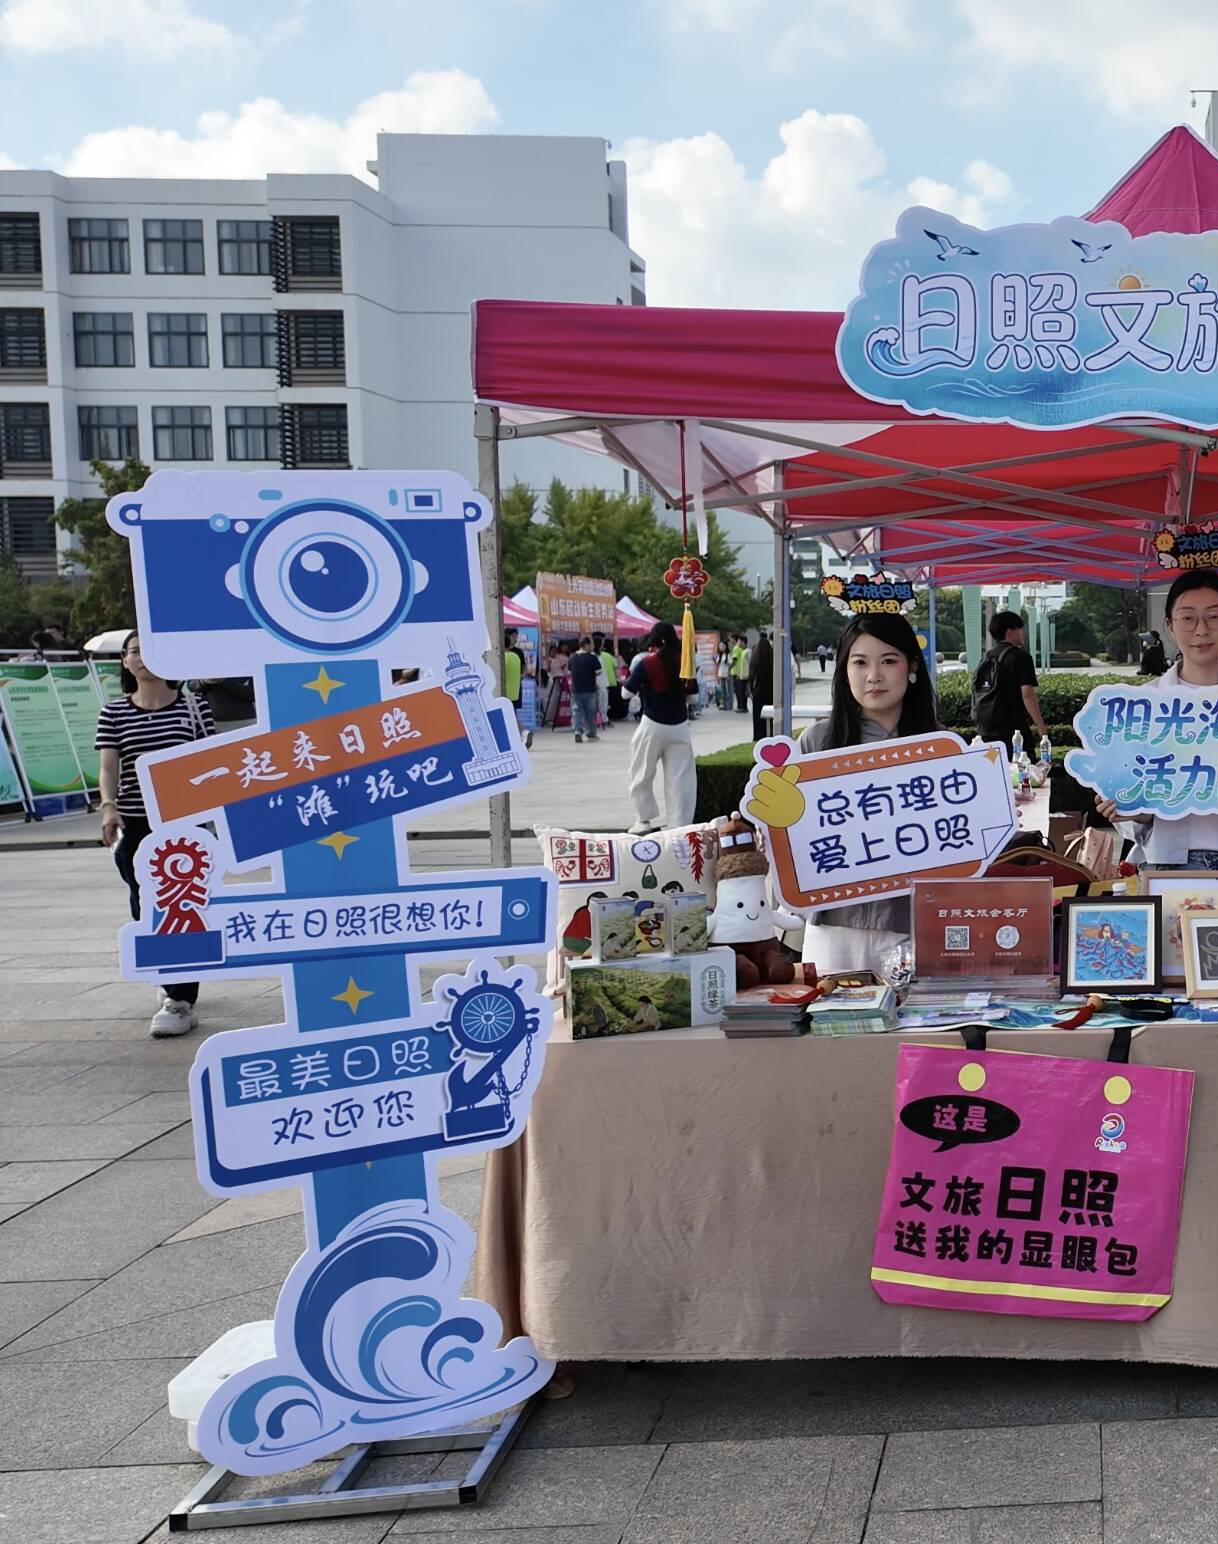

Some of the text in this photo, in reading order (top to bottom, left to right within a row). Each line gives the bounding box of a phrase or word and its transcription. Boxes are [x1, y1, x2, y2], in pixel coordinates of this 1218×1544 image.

[846, 580, 913, 599] 文旅日照
[849, 599, 900, 613] 粉丝团
[189, 706, 423, 789] 一起来日照
[817, 768, 977, 827] 总有理由
[809, 814, 974, 874] 爱上日照
[938, 908, 1028, 919] 日照文旅会客厅
[236, 1036, 433, 1100] 最美日照
[271, 1089, 415, 1146] 欢迎您
[933, 1104, 988, 1133] 这是
[900, 1165, 1119, 1228] 文旅日照
[893, 1220, 1138, 1277] 送我的显眼包
